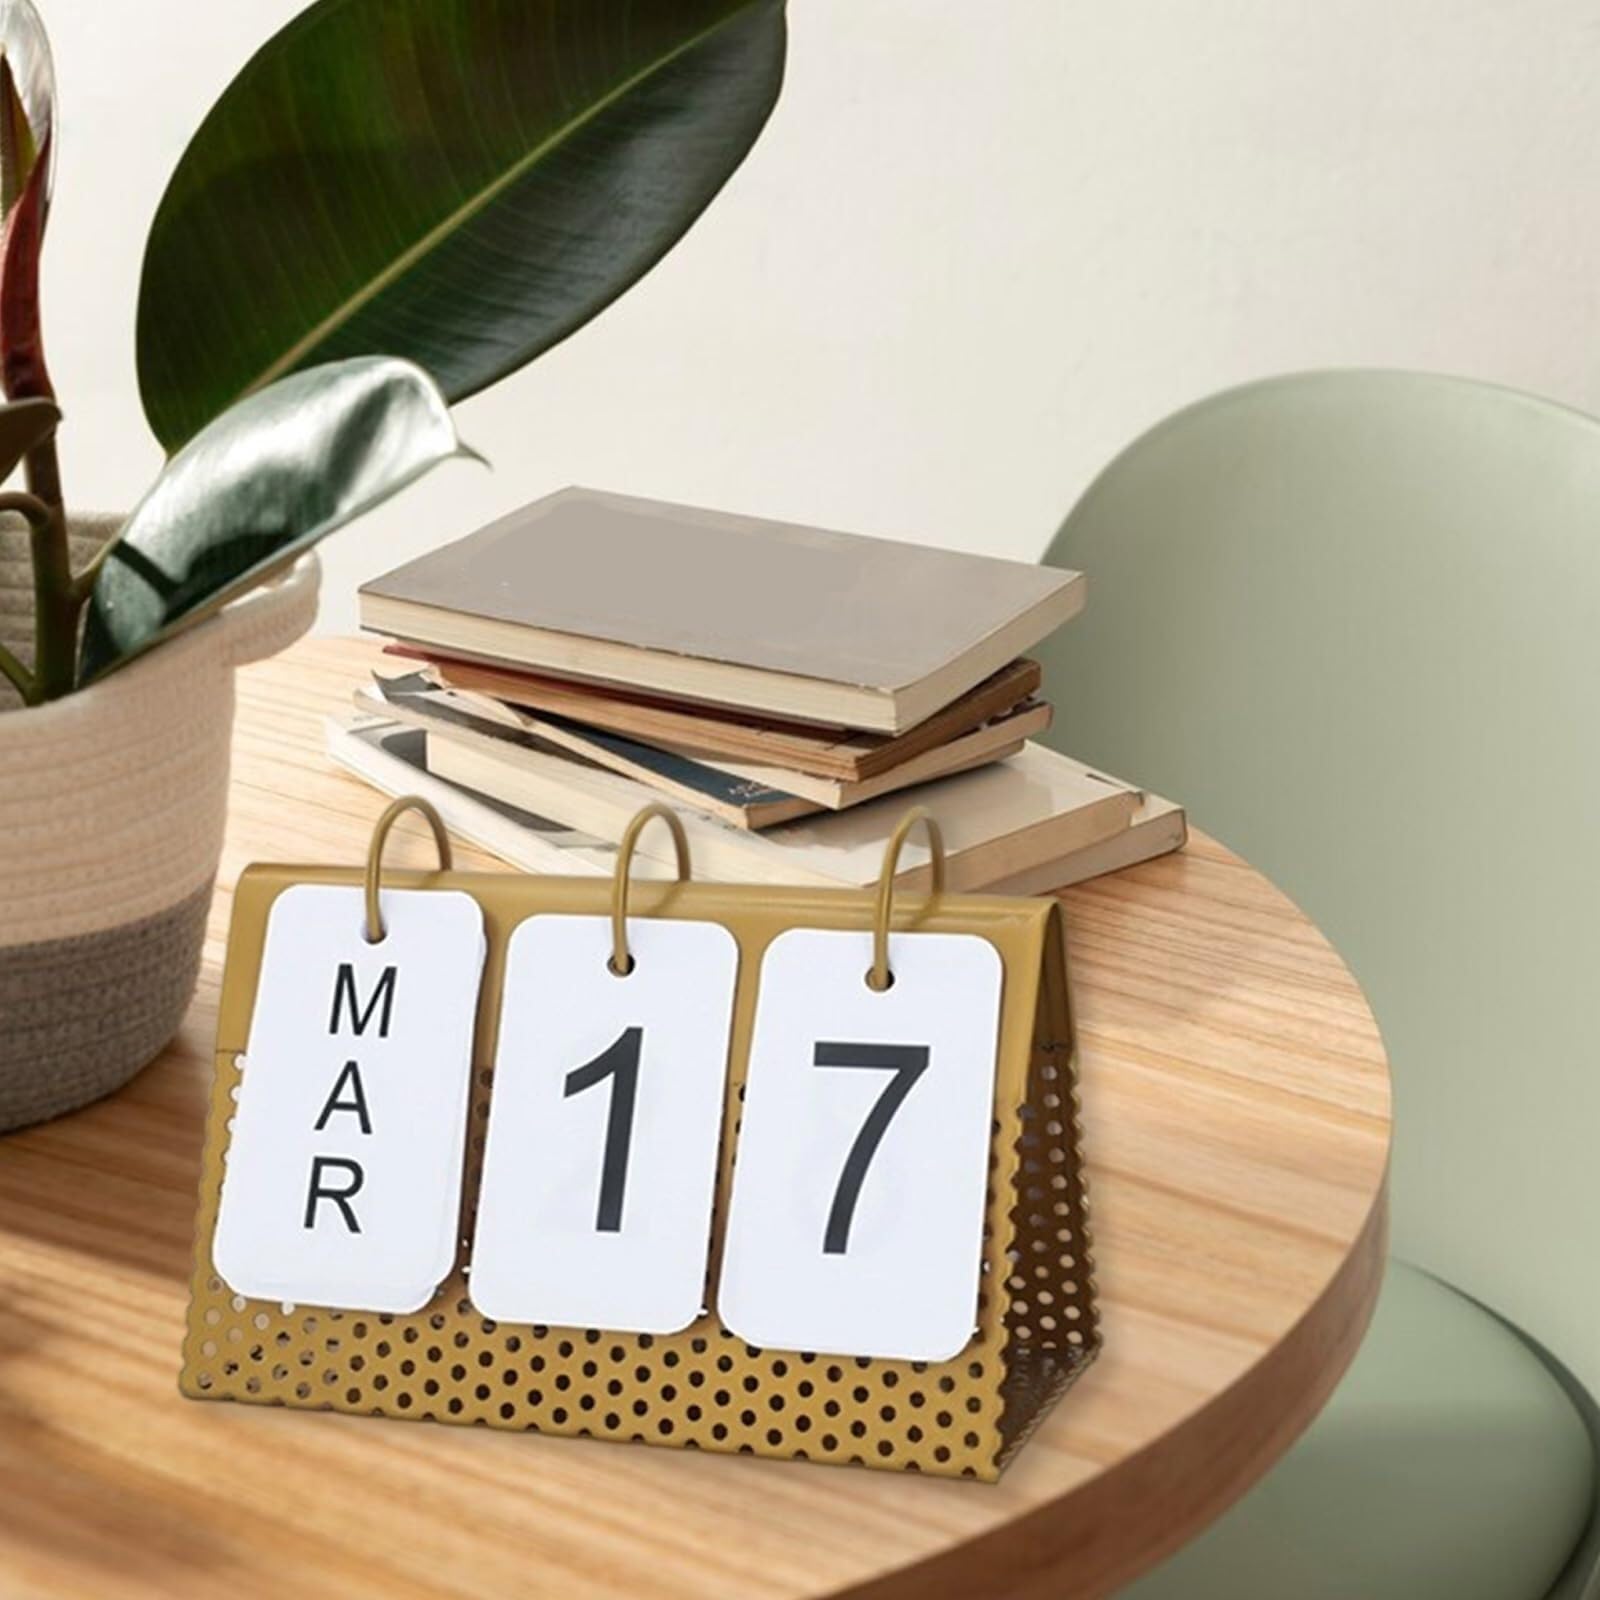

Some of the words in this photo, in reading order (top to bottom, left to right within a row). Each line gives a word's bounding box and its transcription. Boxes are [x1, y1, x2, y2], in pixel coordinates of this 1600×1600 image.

[305, 964, 396, 1233] MAR
[565, 1028, 643, 1233] 1
[814, 1042, 929, 1254] 7
